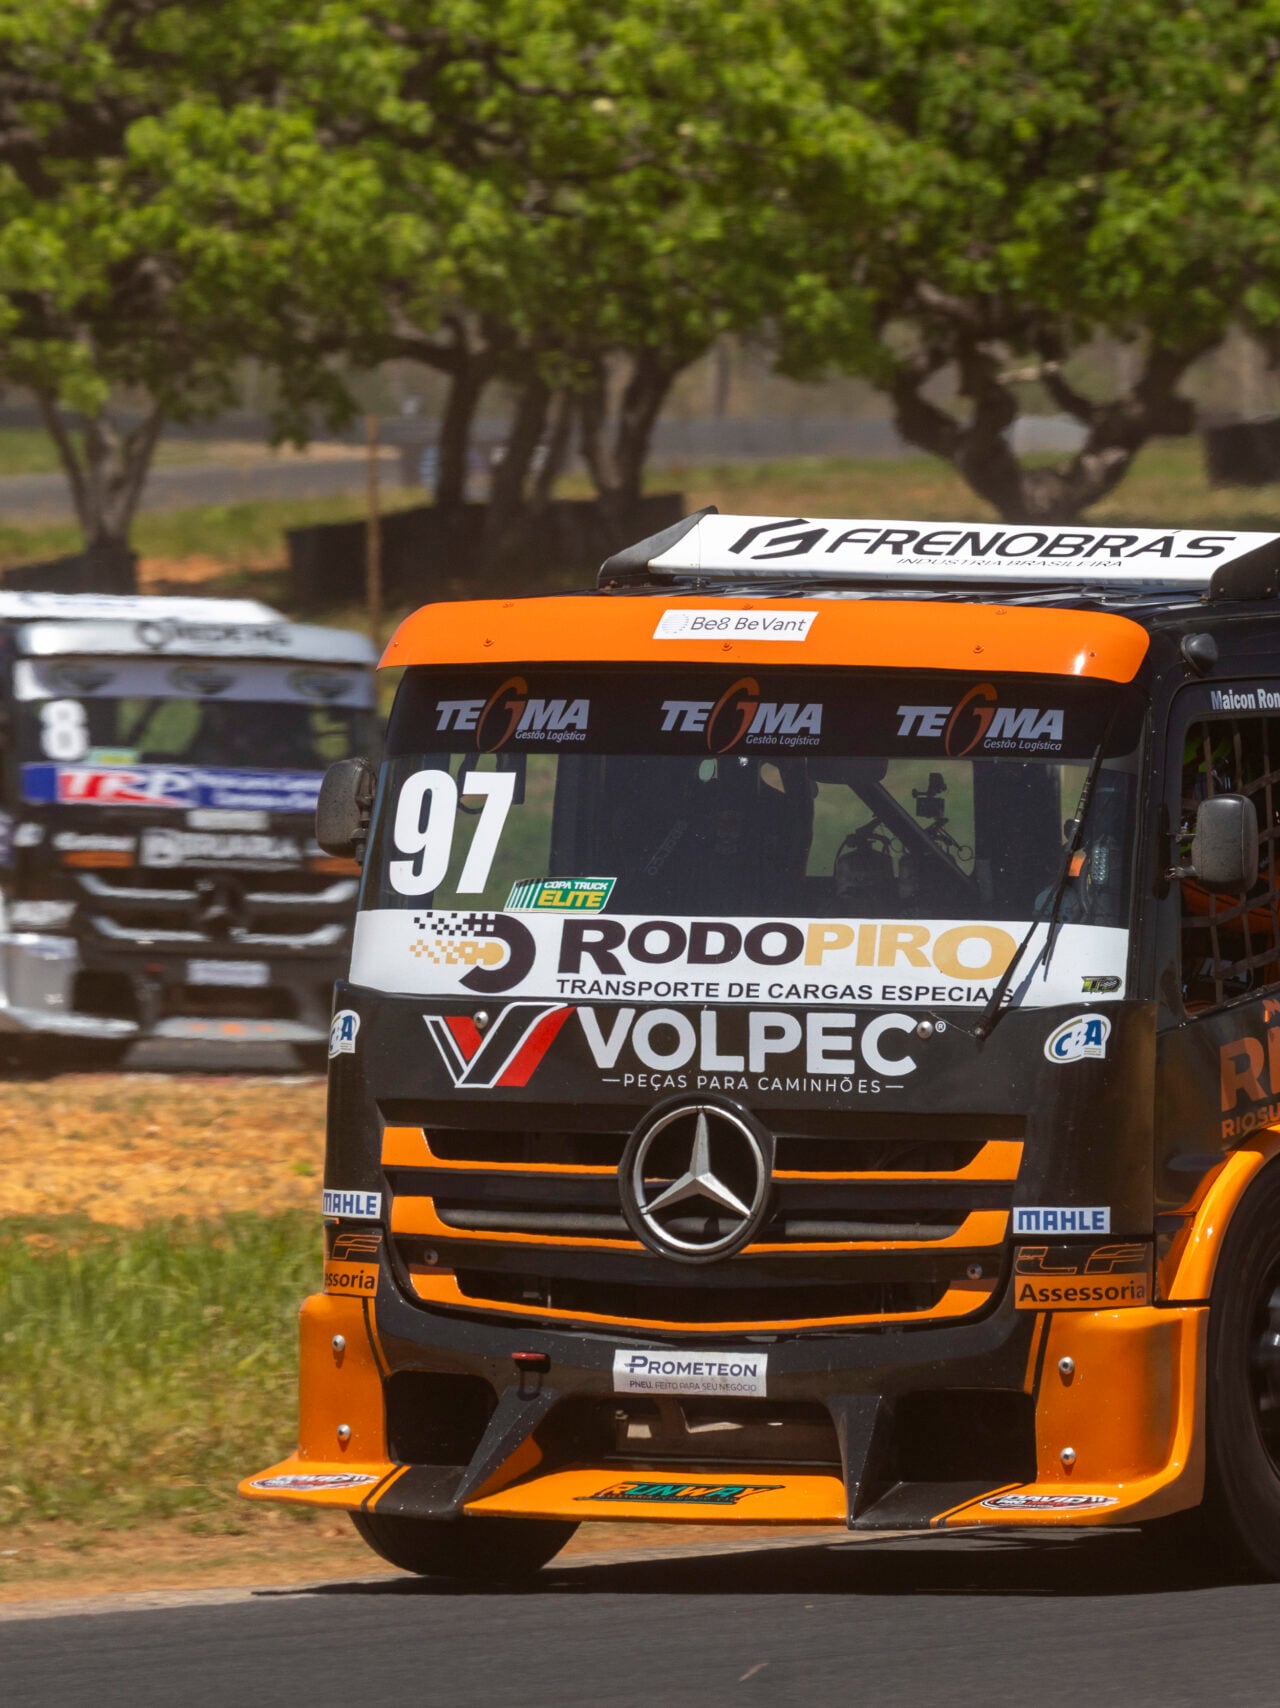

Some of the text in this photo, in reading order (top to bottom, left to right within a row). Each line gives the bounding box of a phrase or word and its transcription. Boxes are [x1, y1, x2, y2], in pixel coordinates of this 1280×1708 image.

[826, 527, 1236, 559] FRENOBRÁS
[691, 616, 807, 632] Be8 BeVant
[1210, 689, 1256, 710] Maicon
[436, 676, 590, 753] TEGMA
[660, 676, 823, 753] TEGMA
[896, 683, 1064, 757] TEGMA
[40, 699, 89, 760] 8
[515, 729, 586, 743] Gestão Logística
[746, 734, 820, 748] Gestão Logística
[983, 738, 1062, 752] Gestão Logística
[389, 769, 517, 896] 97
[544, 881, 609, 890] COPA TRUCK
[538, 889, 606, 907] ELITE
[557, 918, 1018, 980] RODOPIRO
[556, 979, 720, 998] TRANSPORTE
[727, 982, 761, 999] DE
[767, 983, 873, 1000] CARGAS
[576, 1006, 918, 1077] VOLPEC
[1055, 1020, 1102, 1057] CBA
[624, 1074, 881, 1094] PEÇAS PARA CAMINHÕES
[323, 1193, 377, 1216] MAHLE
[1018, 1211, 1105, 1231] MAHLE
[1019, 1280, 1146, 1302] Assessoria
[627, 1355, 757, 1377] PROMETEON
[603, 1484, 778, 1498] RUNWAY
